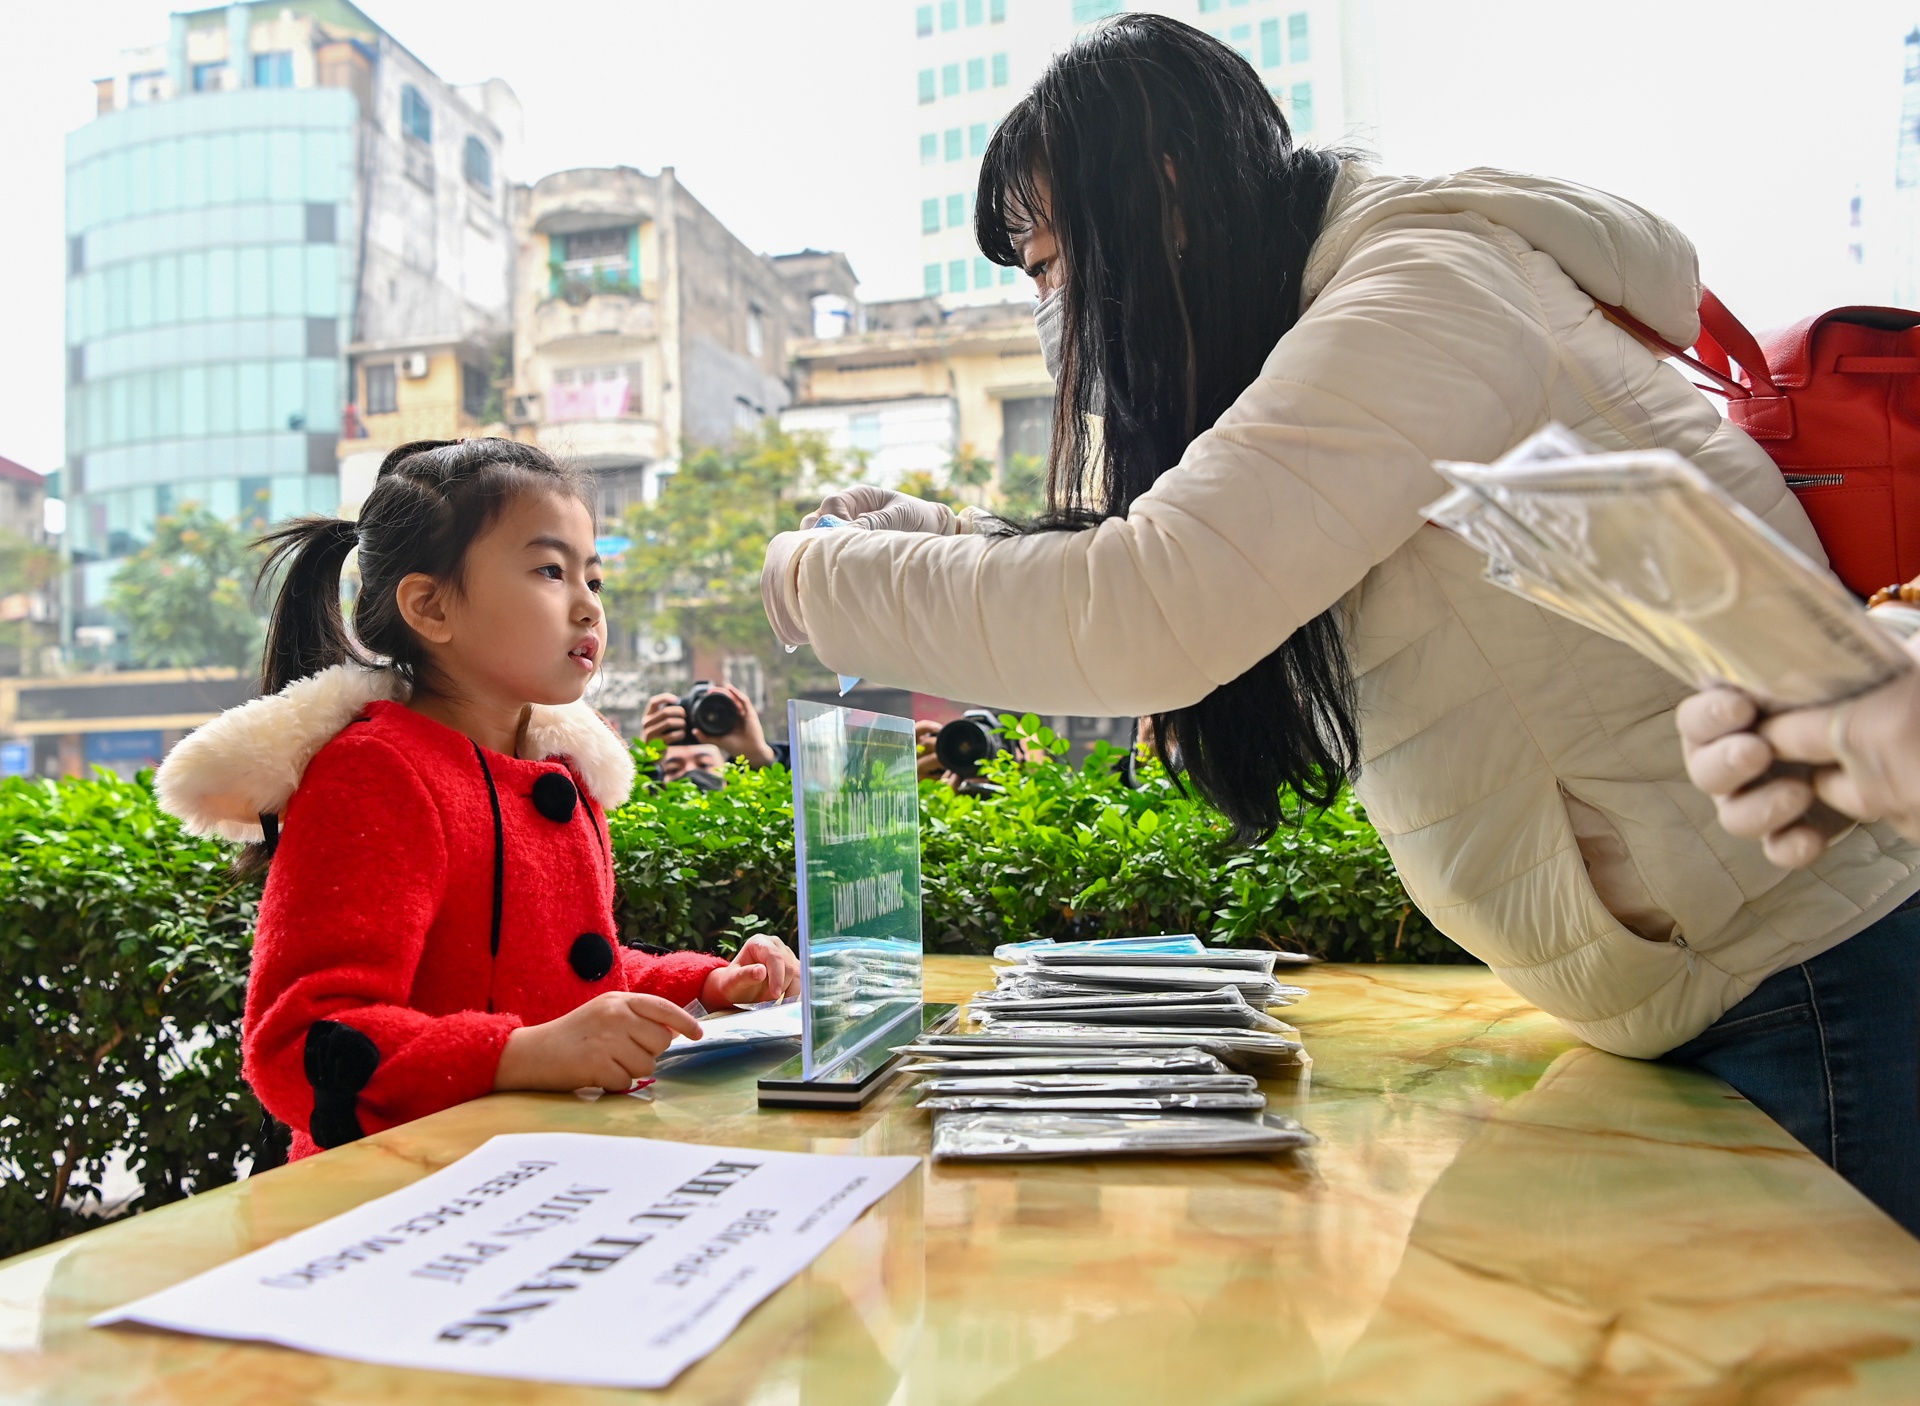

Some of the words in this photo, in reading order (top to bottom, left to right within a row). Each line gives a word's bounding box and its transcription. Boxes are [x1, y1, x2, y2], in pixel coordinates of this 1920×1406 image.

[833, 881, 855, 933] LAND
[856, 876, 877, 924] TOUR
[878, 869, 904, 916] SERVICE
[467, 1160, 558, 1196] (FREE
[390, 1197, 484, 1235] FACE
[259, 1234, 405, 1289] MASK)
[436, 1232, 656, 1345] TRANG
